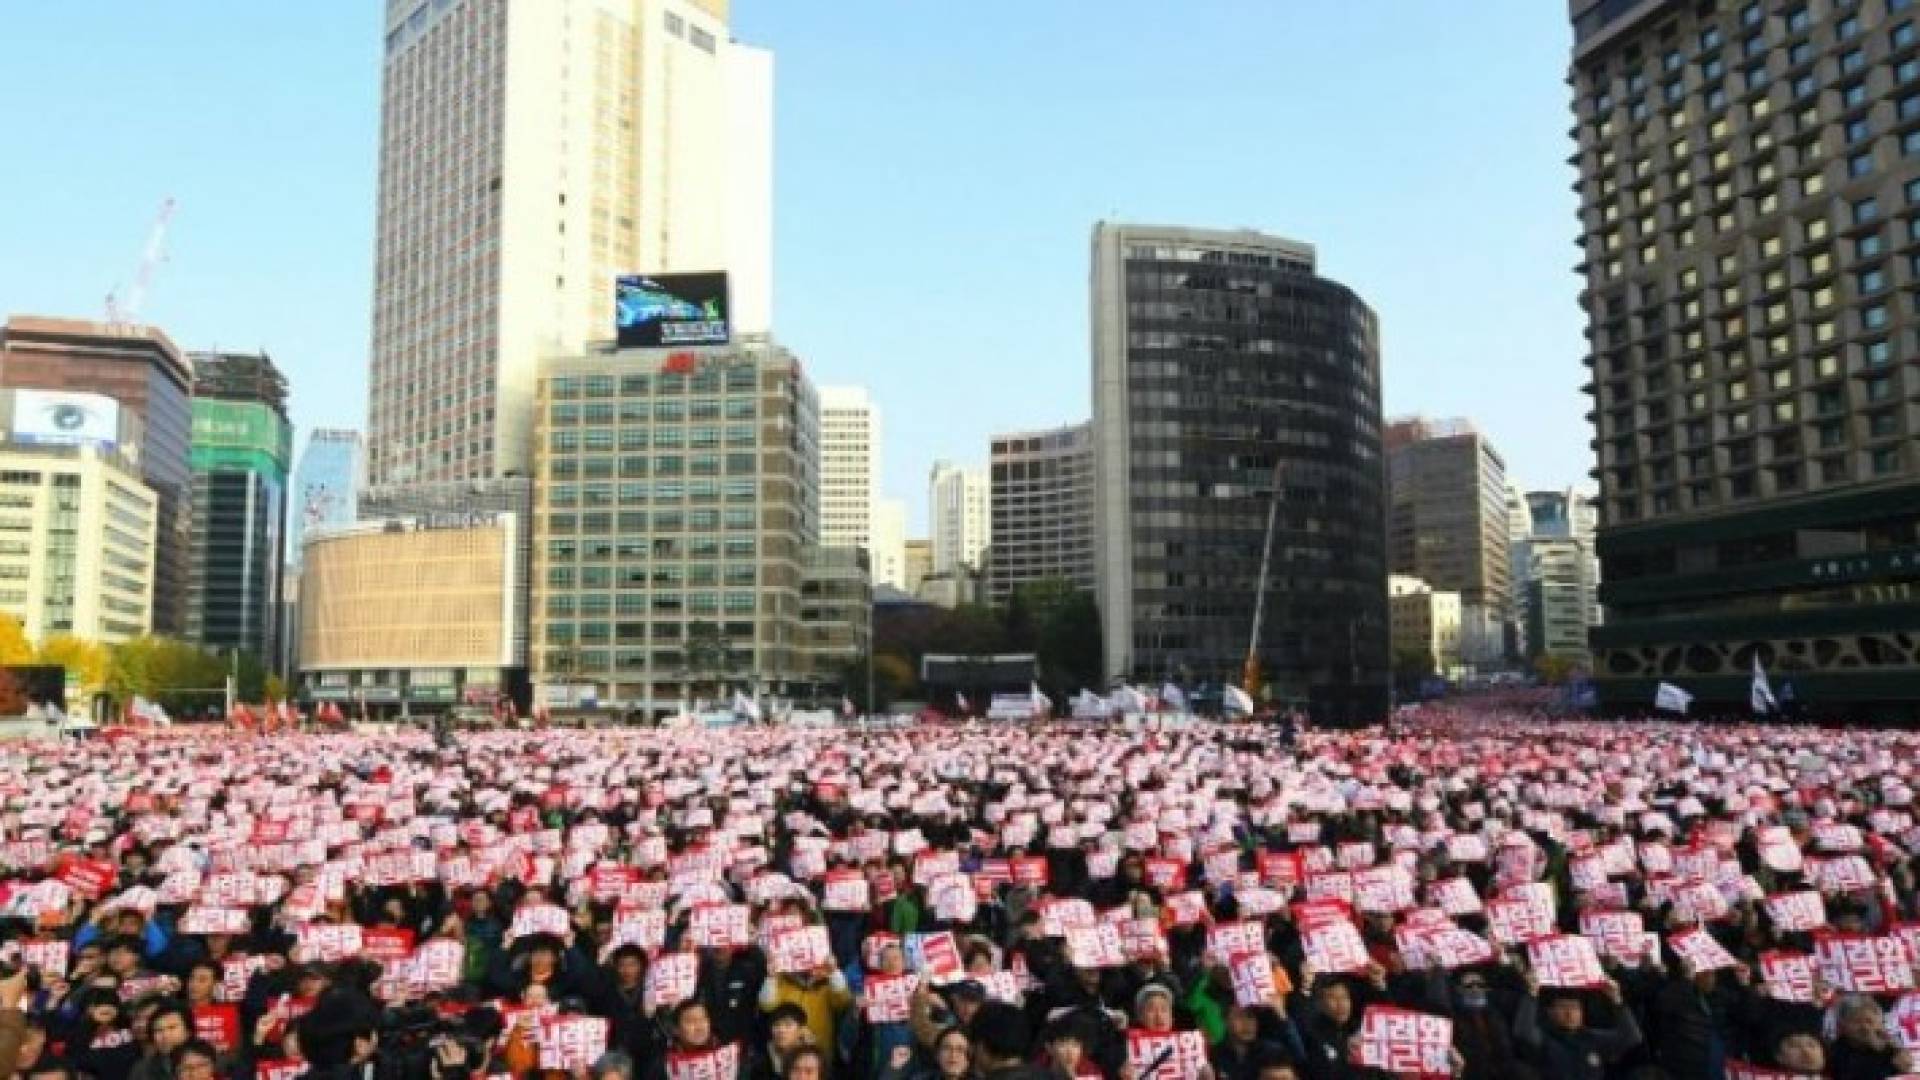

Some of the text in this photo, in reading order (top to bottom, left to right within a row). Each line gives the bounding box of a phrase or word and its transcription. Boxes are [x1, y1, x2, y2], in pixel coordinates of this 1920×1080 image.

[1814, 937, 1902, 970] 내려와
[1820, 961, 1914, 994] 박근혜
[540, 1018, 607, 1048] 내려와
[1363, 1008, 1452, 1044] 내려와
[1128, 1031, 1208, 1066] 내려와
[1363, 1039, 1452, 1074] 박근혜
